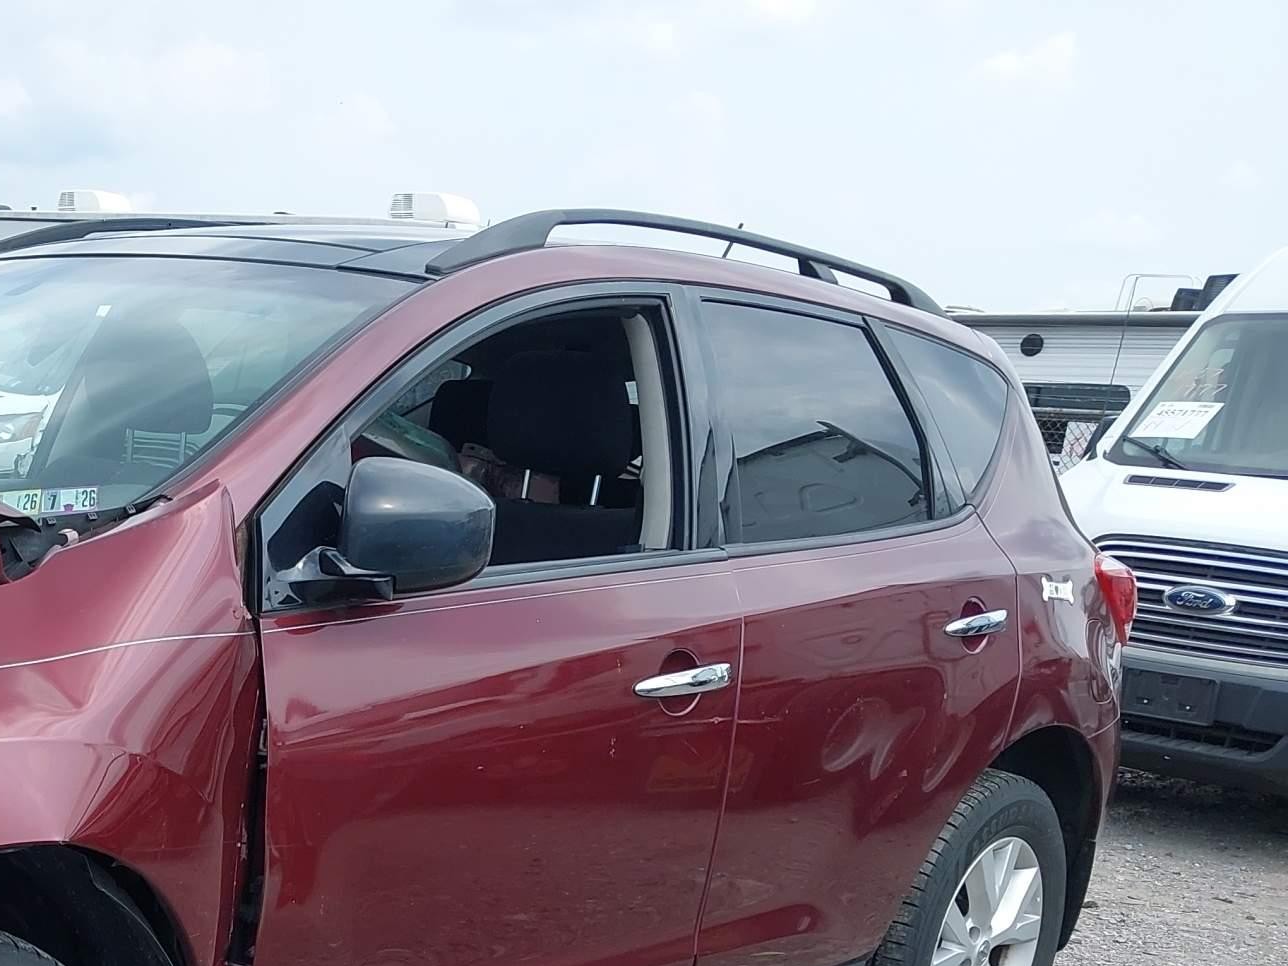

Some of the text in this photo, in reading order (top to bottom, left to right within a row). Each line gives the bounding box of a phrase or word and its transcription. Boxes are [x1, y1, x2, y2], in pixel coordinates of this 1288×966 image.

[22, 493, 38, 511] 26
[81, 489, 96, 508] 26
[1176, 591, 1214, 608] Ford
